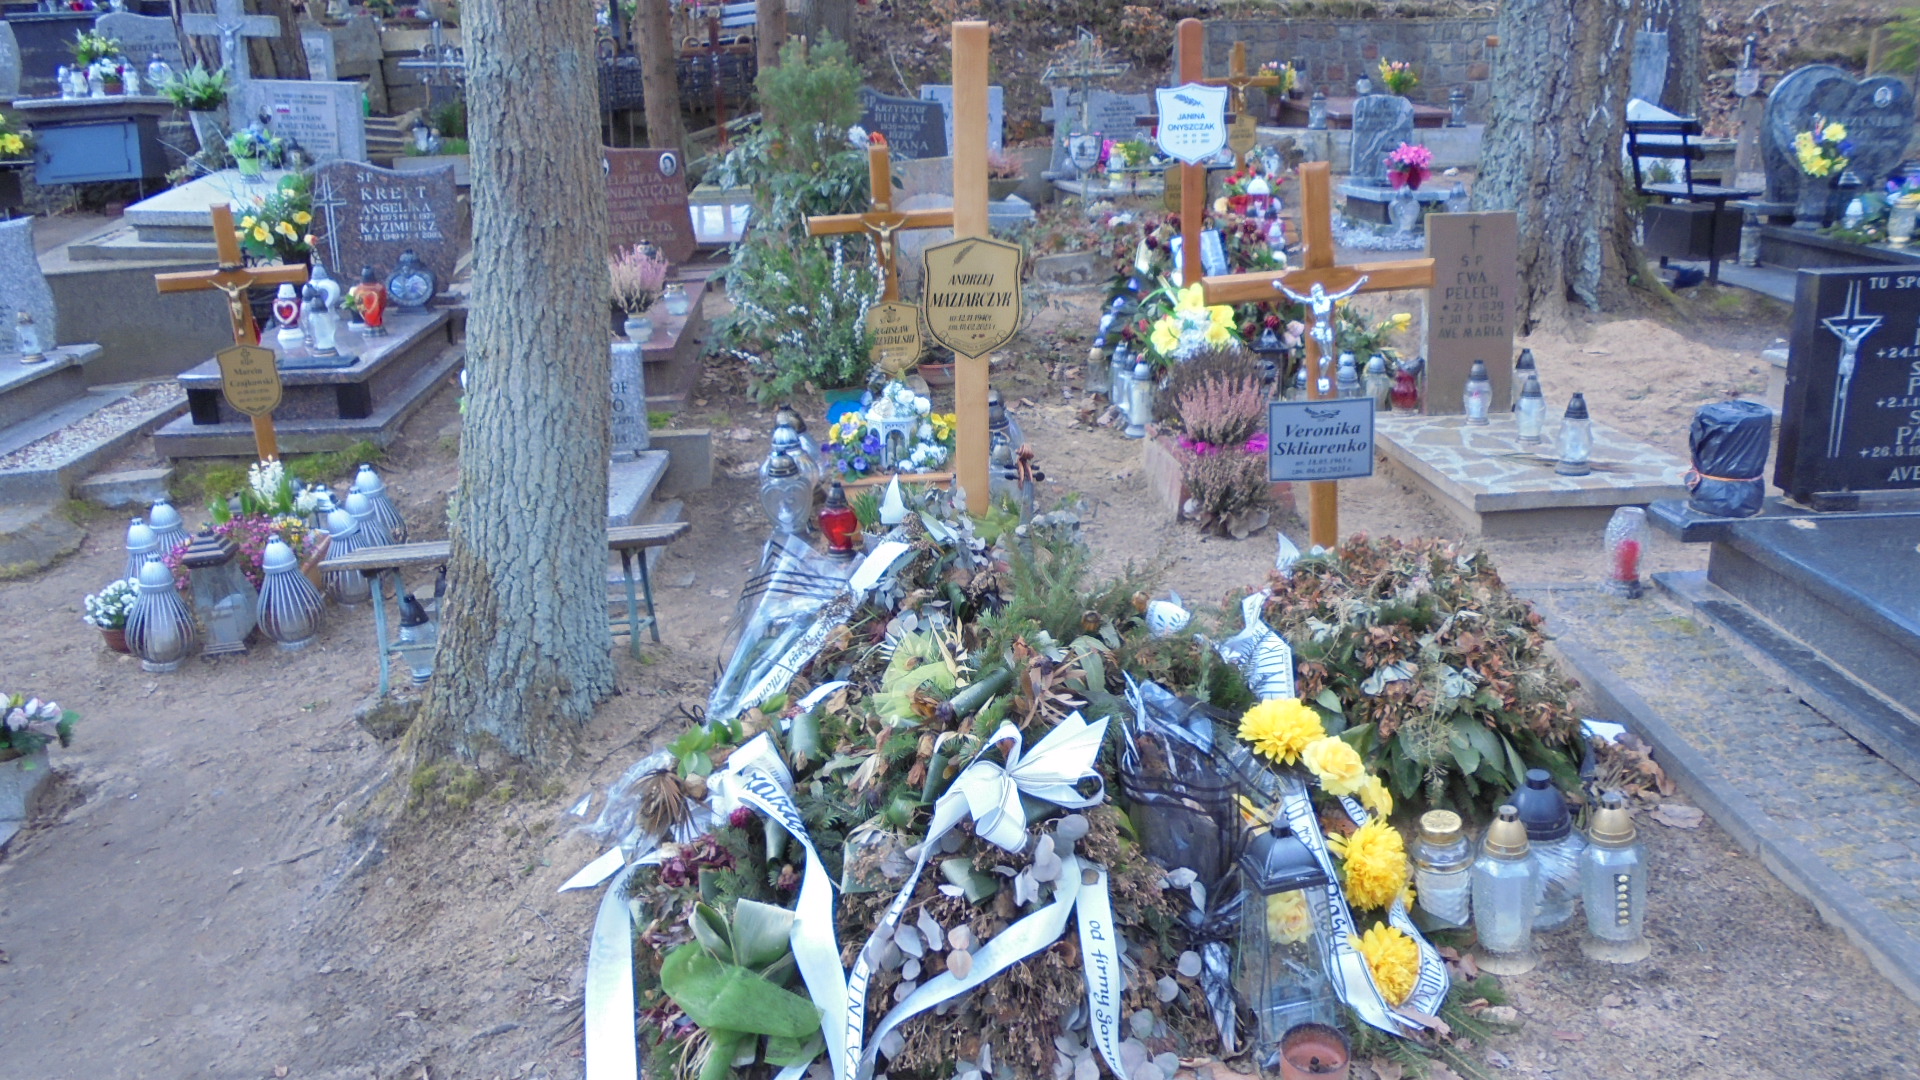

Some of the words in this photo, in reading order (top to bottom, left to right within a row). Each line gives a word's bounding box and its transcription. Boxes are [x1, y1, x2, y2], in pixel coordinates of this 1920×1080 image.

[1177, 113, 1206, 121] JANINA
[1167, 123, 1215, 132] ONYSZCZAK
[948, 273, 995, 288] ANDRZEJ
[1457, 270, 1488, 285] EWA
[1869, 276, 1889, 290] TU
[1285, 421, 1361, 438] Veronika
[1274, 438, 1368, 456] Skliarenko
[1088, 919, 1106, 941] od
[1090, 948, 1110, 1007] firmy
